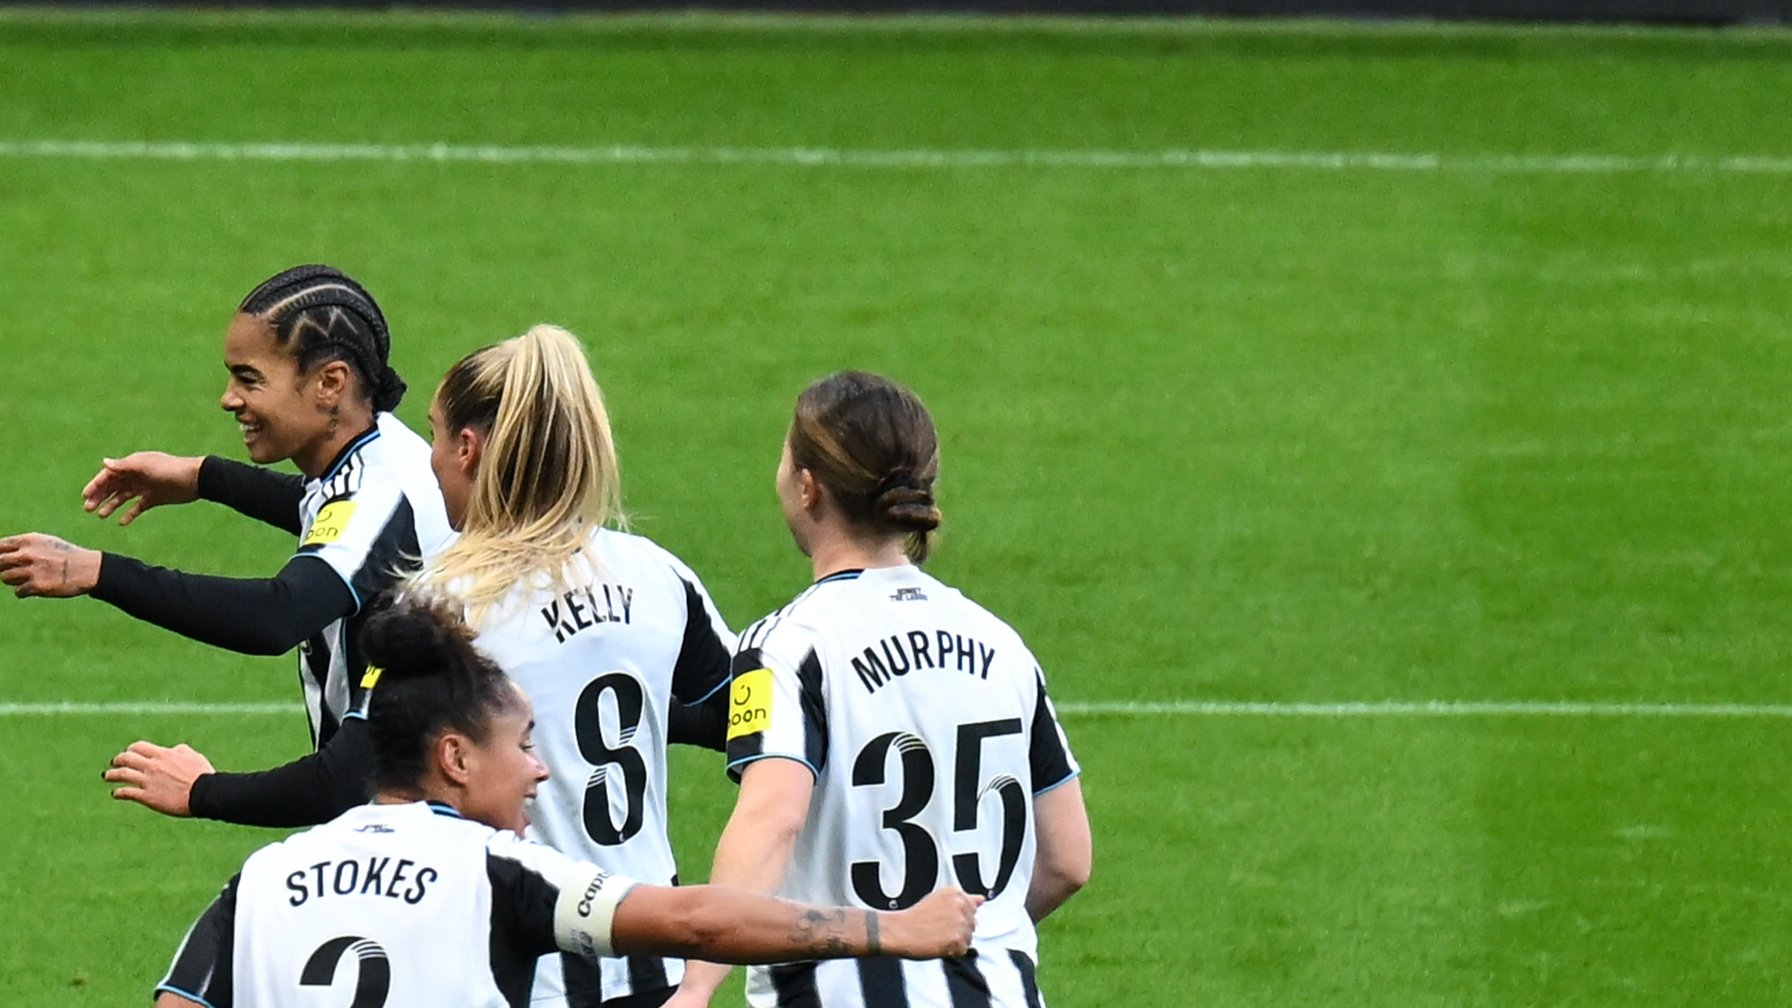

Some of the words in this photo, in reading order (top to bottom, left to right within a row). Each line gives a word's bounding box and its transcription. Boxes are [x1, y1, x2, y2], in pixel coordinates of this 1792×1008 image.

[306, 527, 338, 541] oon
[541, 583, 633, 644] KELLY
[850, 630, 995, 694] MURPHY
[728, 708, 766, 726] oon
[574, 672, 647, 846] 8
[851, 717, 1026, 911] 35
[286, 857, 438, 907] STOKES
